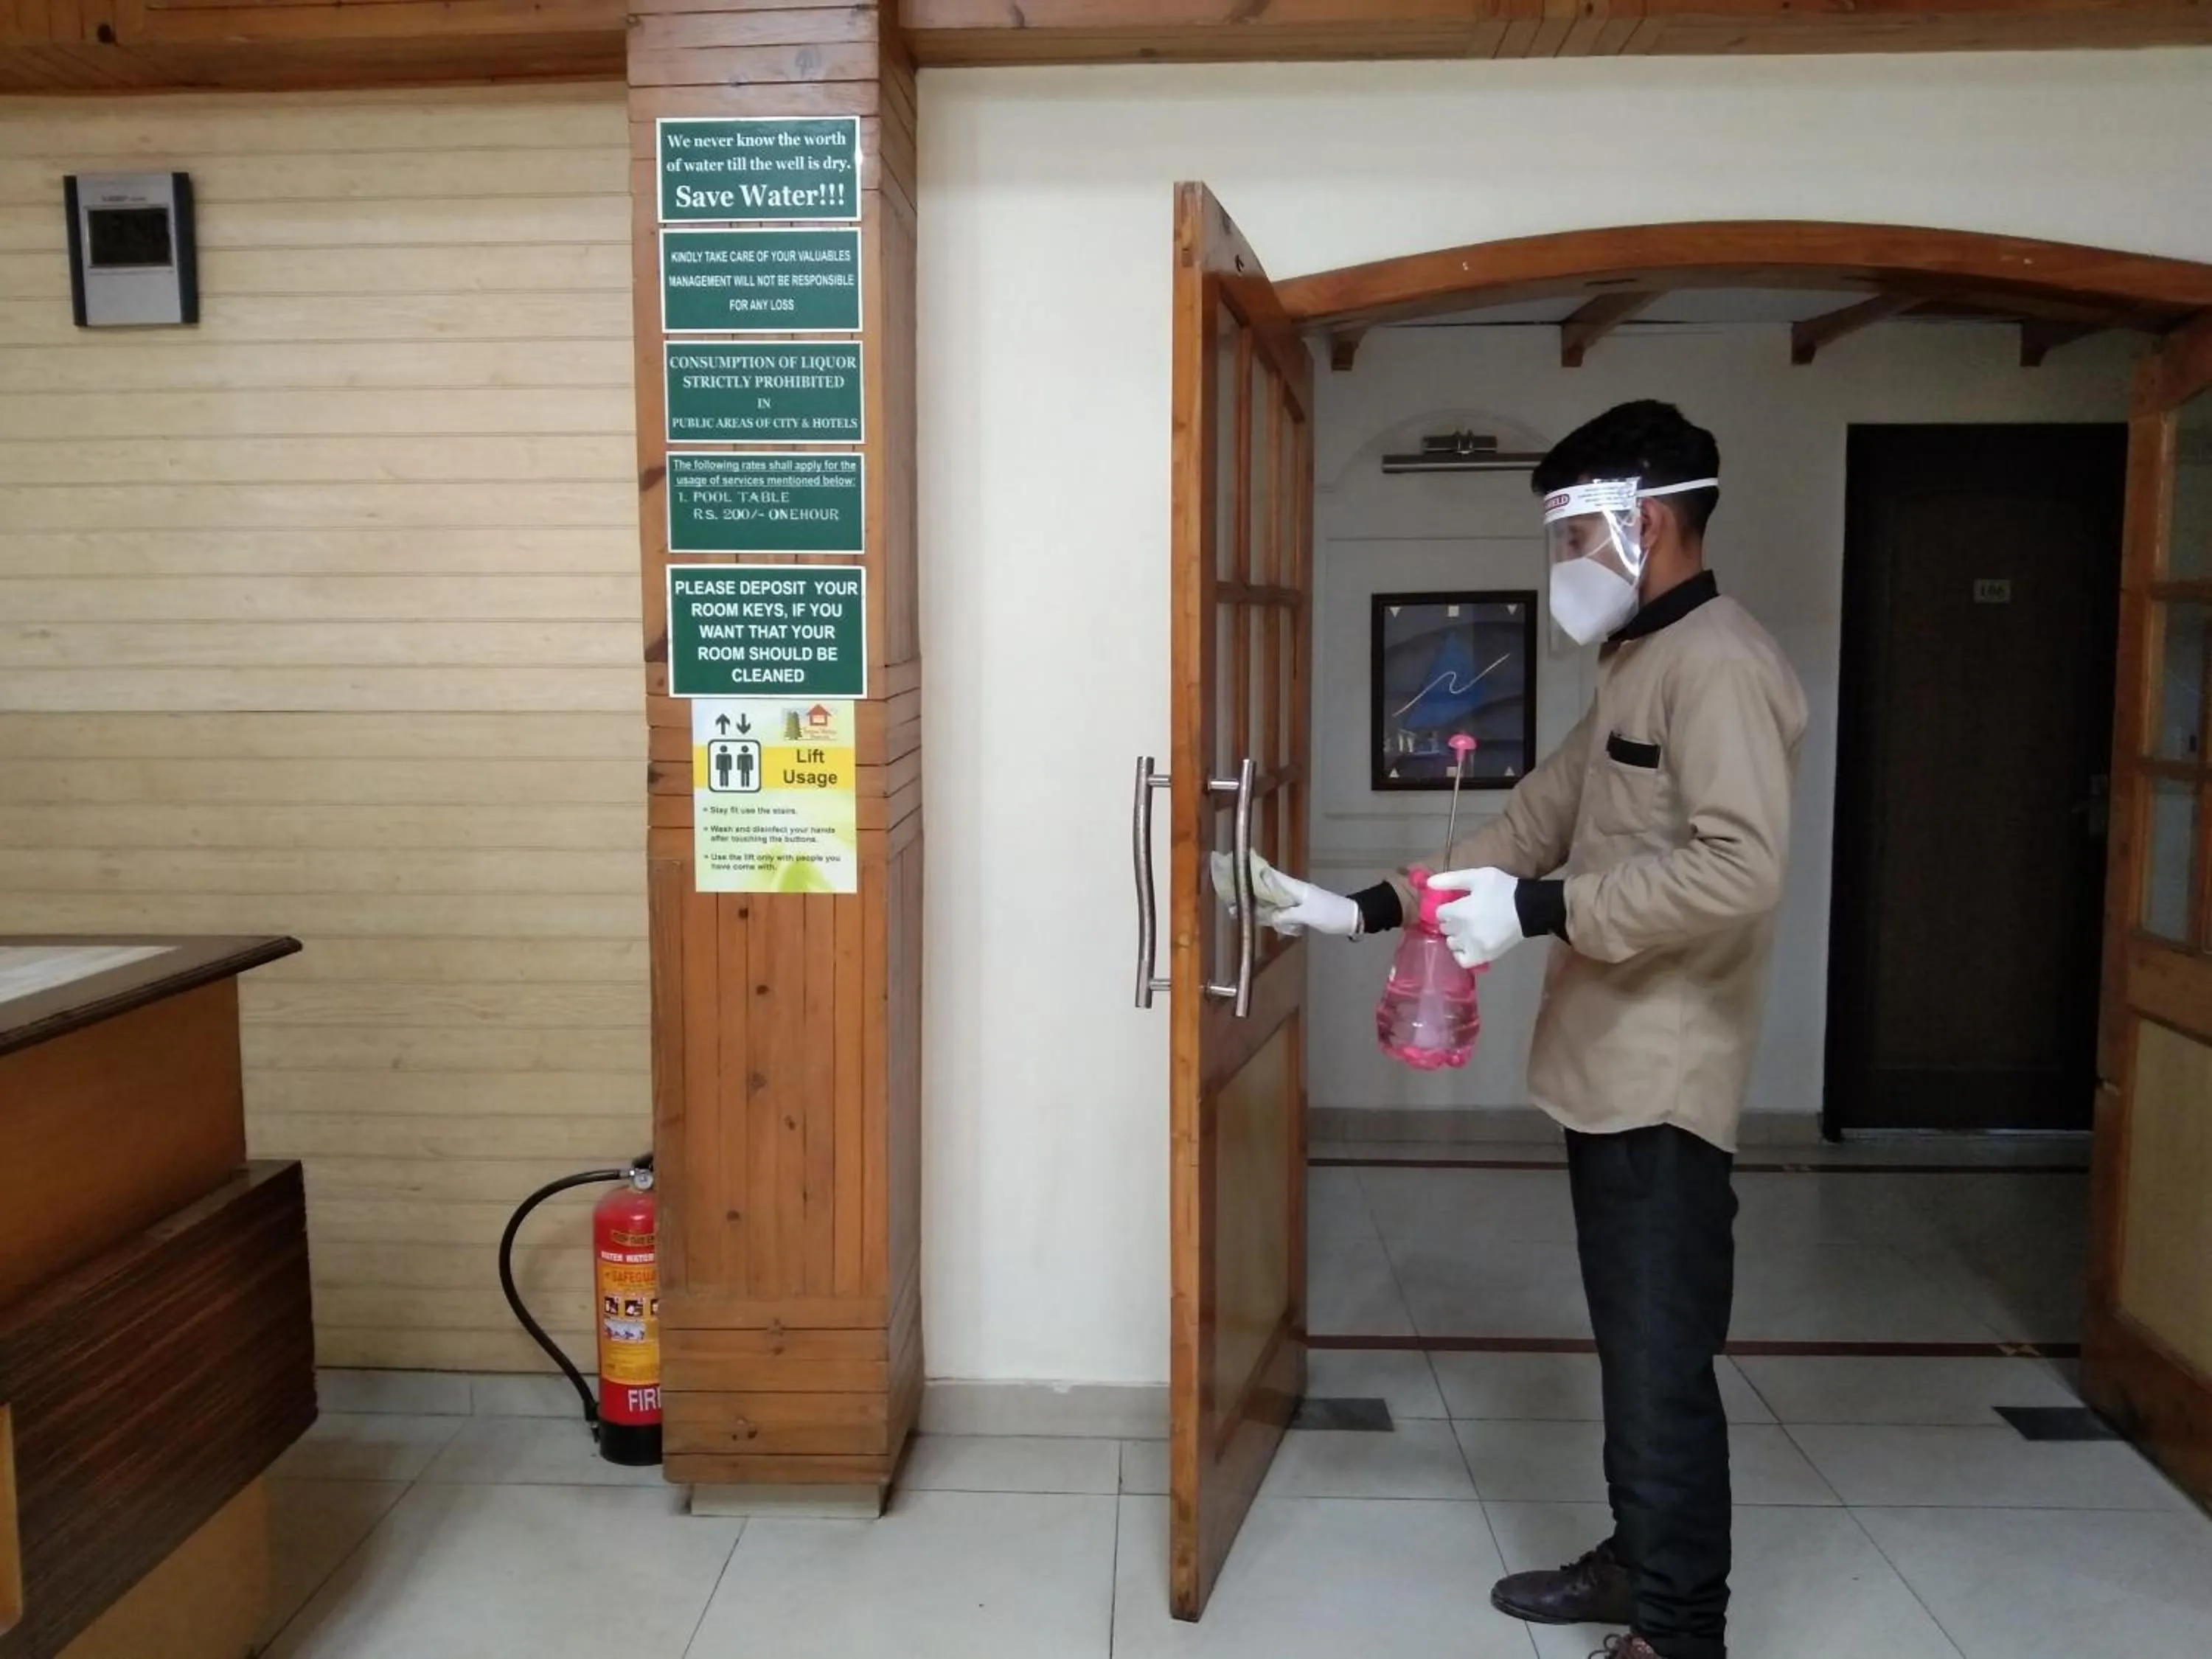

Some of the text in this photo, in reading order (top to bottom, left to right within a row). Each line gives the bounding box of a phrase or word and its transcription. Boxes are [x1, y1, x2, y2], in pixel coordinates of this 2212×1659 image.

[667, 132, 846, 147] We never know the worth
[667, 156, 851, 173] of water till the well is dry.
[675, 184, 844, 207] Save Water!!!
[671, 250, 850, 262] KINDLY TAKE CARE OF YOUR VALUABLES
[669, 274, 855, 287] MANAGEMENT WILL NOT BE RESPONSIBLE
[729, 299, 794, 310] FOR ANY LOSS
[669, 357, 857, 371] CONSUMPTION OF LIQUOR
[683, 375, 844, 389] STRICTLY PROHIBITED
[757, 398, 771, 408] IN
[672, 418, 858, 428] PUBLIC AREAS OF CITY & HOTELS
[674, 459, 856, 472] The following rates shall apply for the
[676, 477, 706, 486] usage
[709, 476, 720, 484] of
[723, 476, 765, 485] services
[767, 476, 820, 485] mentioned
[678, 492, 790, 503] 1. POOL TABLE
[693, 509, 718, 520] RS.
[723, 509, 764, 520] 200/-
[675, 580, 858, 595] PLEASE DEPOSIT YOUR
[692, 603, 842, 619] ROOM KEYS, IF YOU
[699, 625, 835, 639] WANT THAT YOUR
[698, 647, 838, 661] ROOM SHOULD BE
[731, 669, 804, 683] CLEANED
[796, 748, 824, 763] Lift
[783, 770, 838, 787] Usage
[710, 807, 728, 815] Stay
[790, 827, 809, 835] your
[731, 835, 768, 844] touching
[796, 855, 823, 863] people
